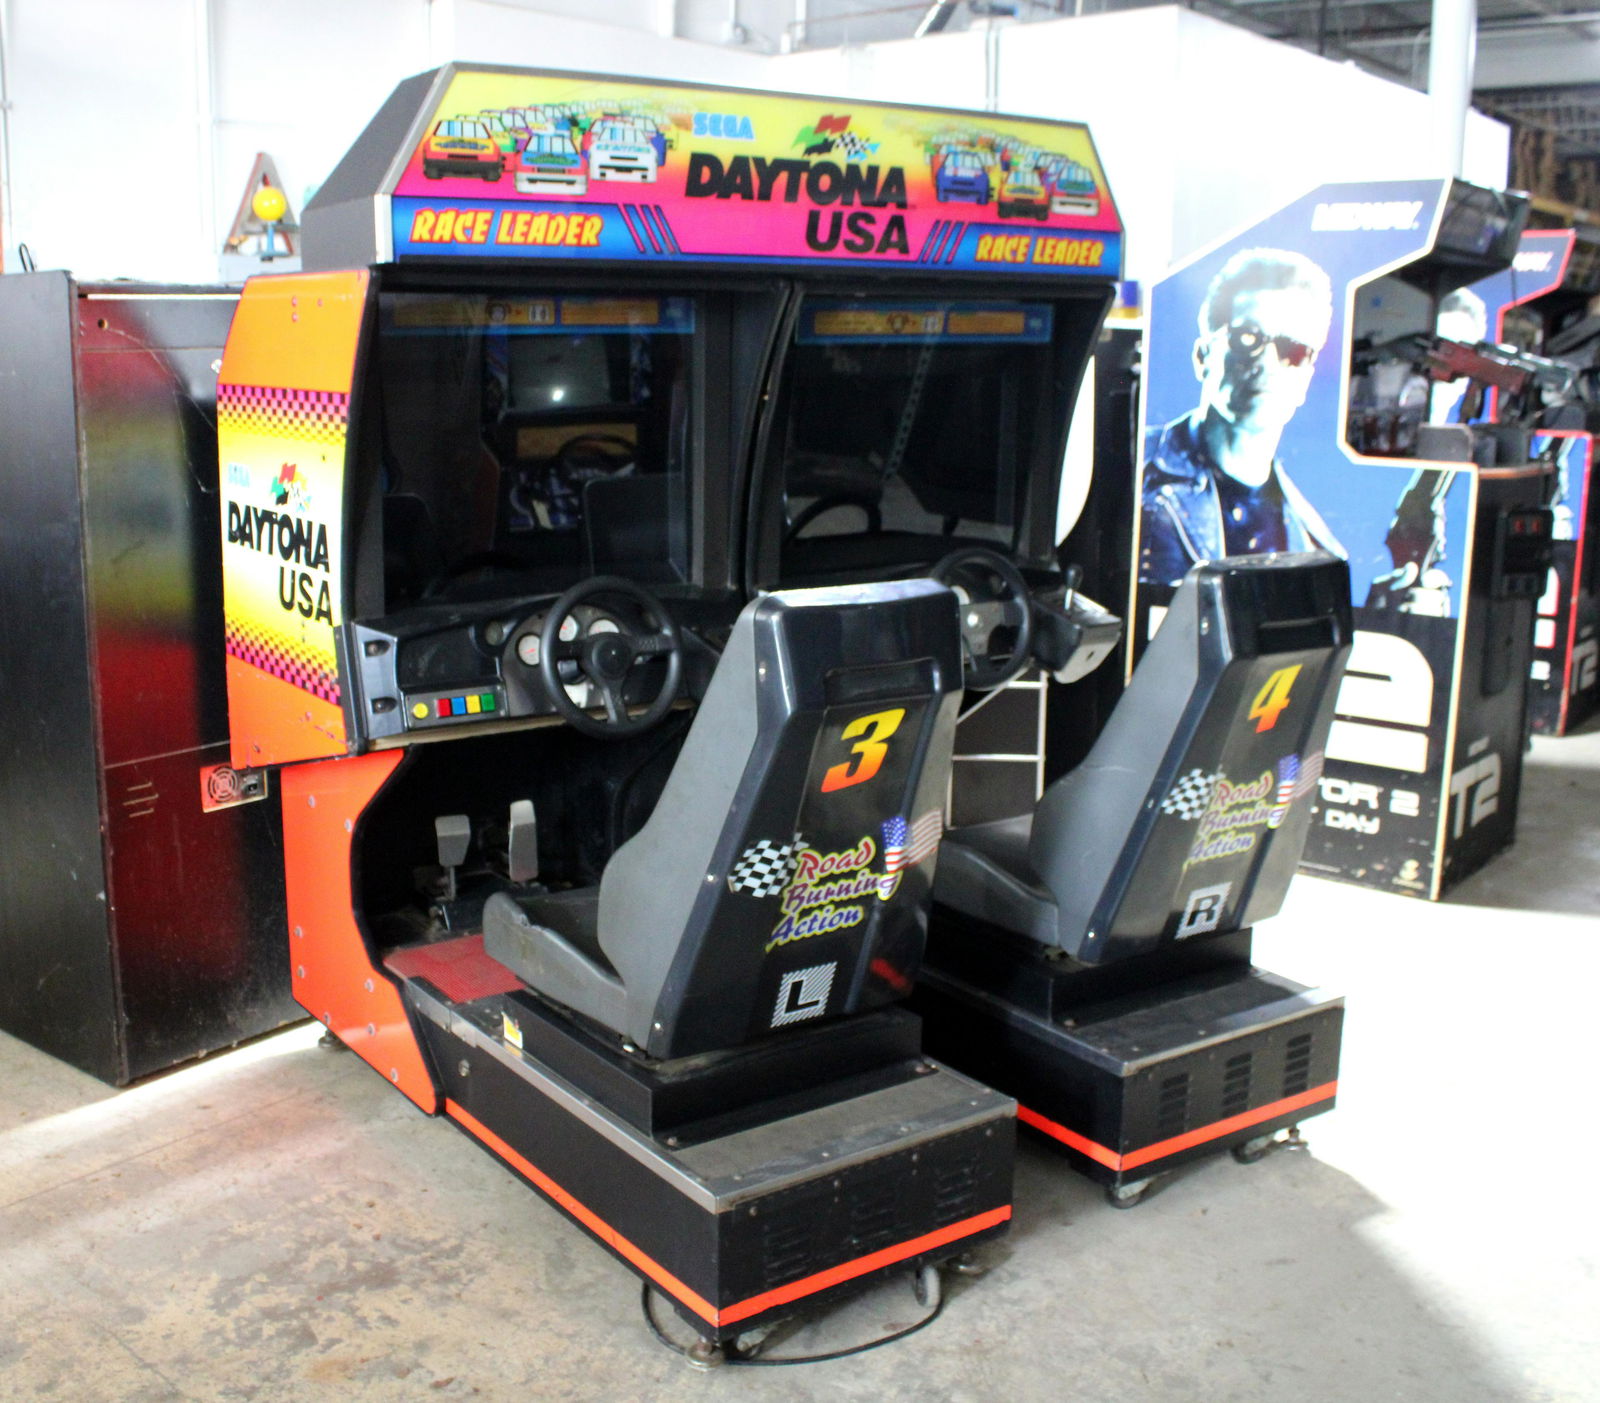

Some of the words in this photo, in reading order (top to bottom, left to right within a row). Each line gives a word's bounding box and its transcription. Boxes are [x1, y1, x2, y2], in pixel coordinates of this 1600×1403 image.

[692, 112, 755, 140] SEGA
[685, 153, 909, 209] DAYTONA
[409, 208, 493, 243] RACE
[495, 210, 604, 247] LEADER
[805, 209, 909, 255] USA
[975, 234, 1028, 263] RACE
[1032, 236, 1104, 267] LEADER
[228, 500, 330, 573] DAYTONA
[279, 566, 333, 626] USA
[1249, 664, 1303, 733] 4
[821, 708, 906, 793] 3
[1214, 773, 1273, 805] Road
[1202, 802, 1286, 834] Burning
[796, 838, 875, 880] Road
[1190, 833, 1254, 861] Action
[785, 871, 900, 912] Burning
[770, 905, 863, 944] Action
